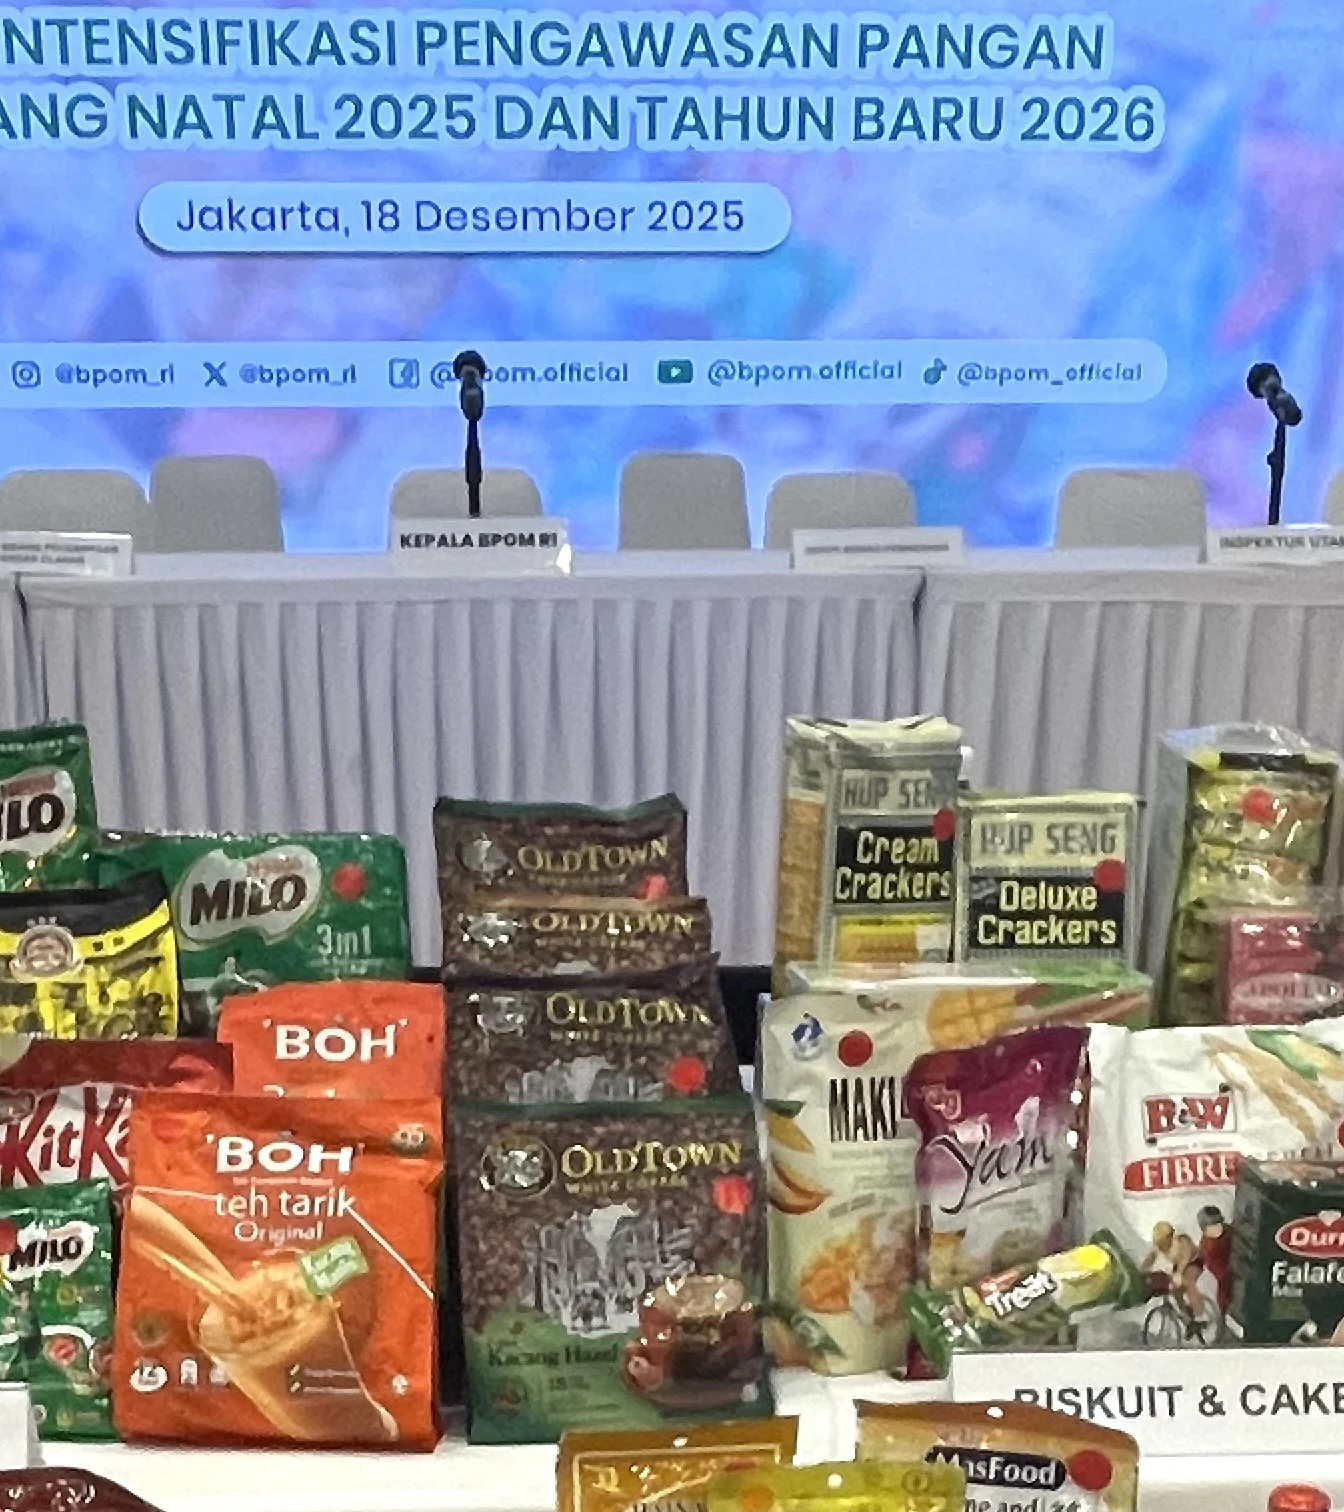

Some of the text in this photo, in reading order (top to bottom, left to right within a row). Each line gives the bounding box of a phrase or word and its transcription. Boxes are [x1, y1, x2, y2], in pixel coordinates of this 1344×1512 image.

[415, 19, 838, 70] PENGAWASAN
[856, 22, 1105, 71] PANGAN
[127, 93, 320, 140] NATAL
[335, 94, 476, 140] 2025
[495, 95, 620, 141] DAN
[636, 95, 836, 141] TAHUN
[853, 95, 1003, 141] BARU
[1020, 95, 1156, 142] 2026
[177, 198, 745, 238] Jakarta, 18 Desember 2025
[707, 358, 903, 387] @bpom.official
[399, 531, 474, 549] KEPALA
[478, 531, 536, 549] BPOM
[855, 832, 940, 866] Cream
[188, 873, 309, 926] MILO
[835, 866, 954, 901] Crackers
[999, 879, 1098, 912] Deluxe
[976, 913, 1117, 948] Crackers
[214, 1188, 356, 1218] teh tarik
[233, 1221, 324, 1247] Original
[1198, 1386, 1227, 1417] &
